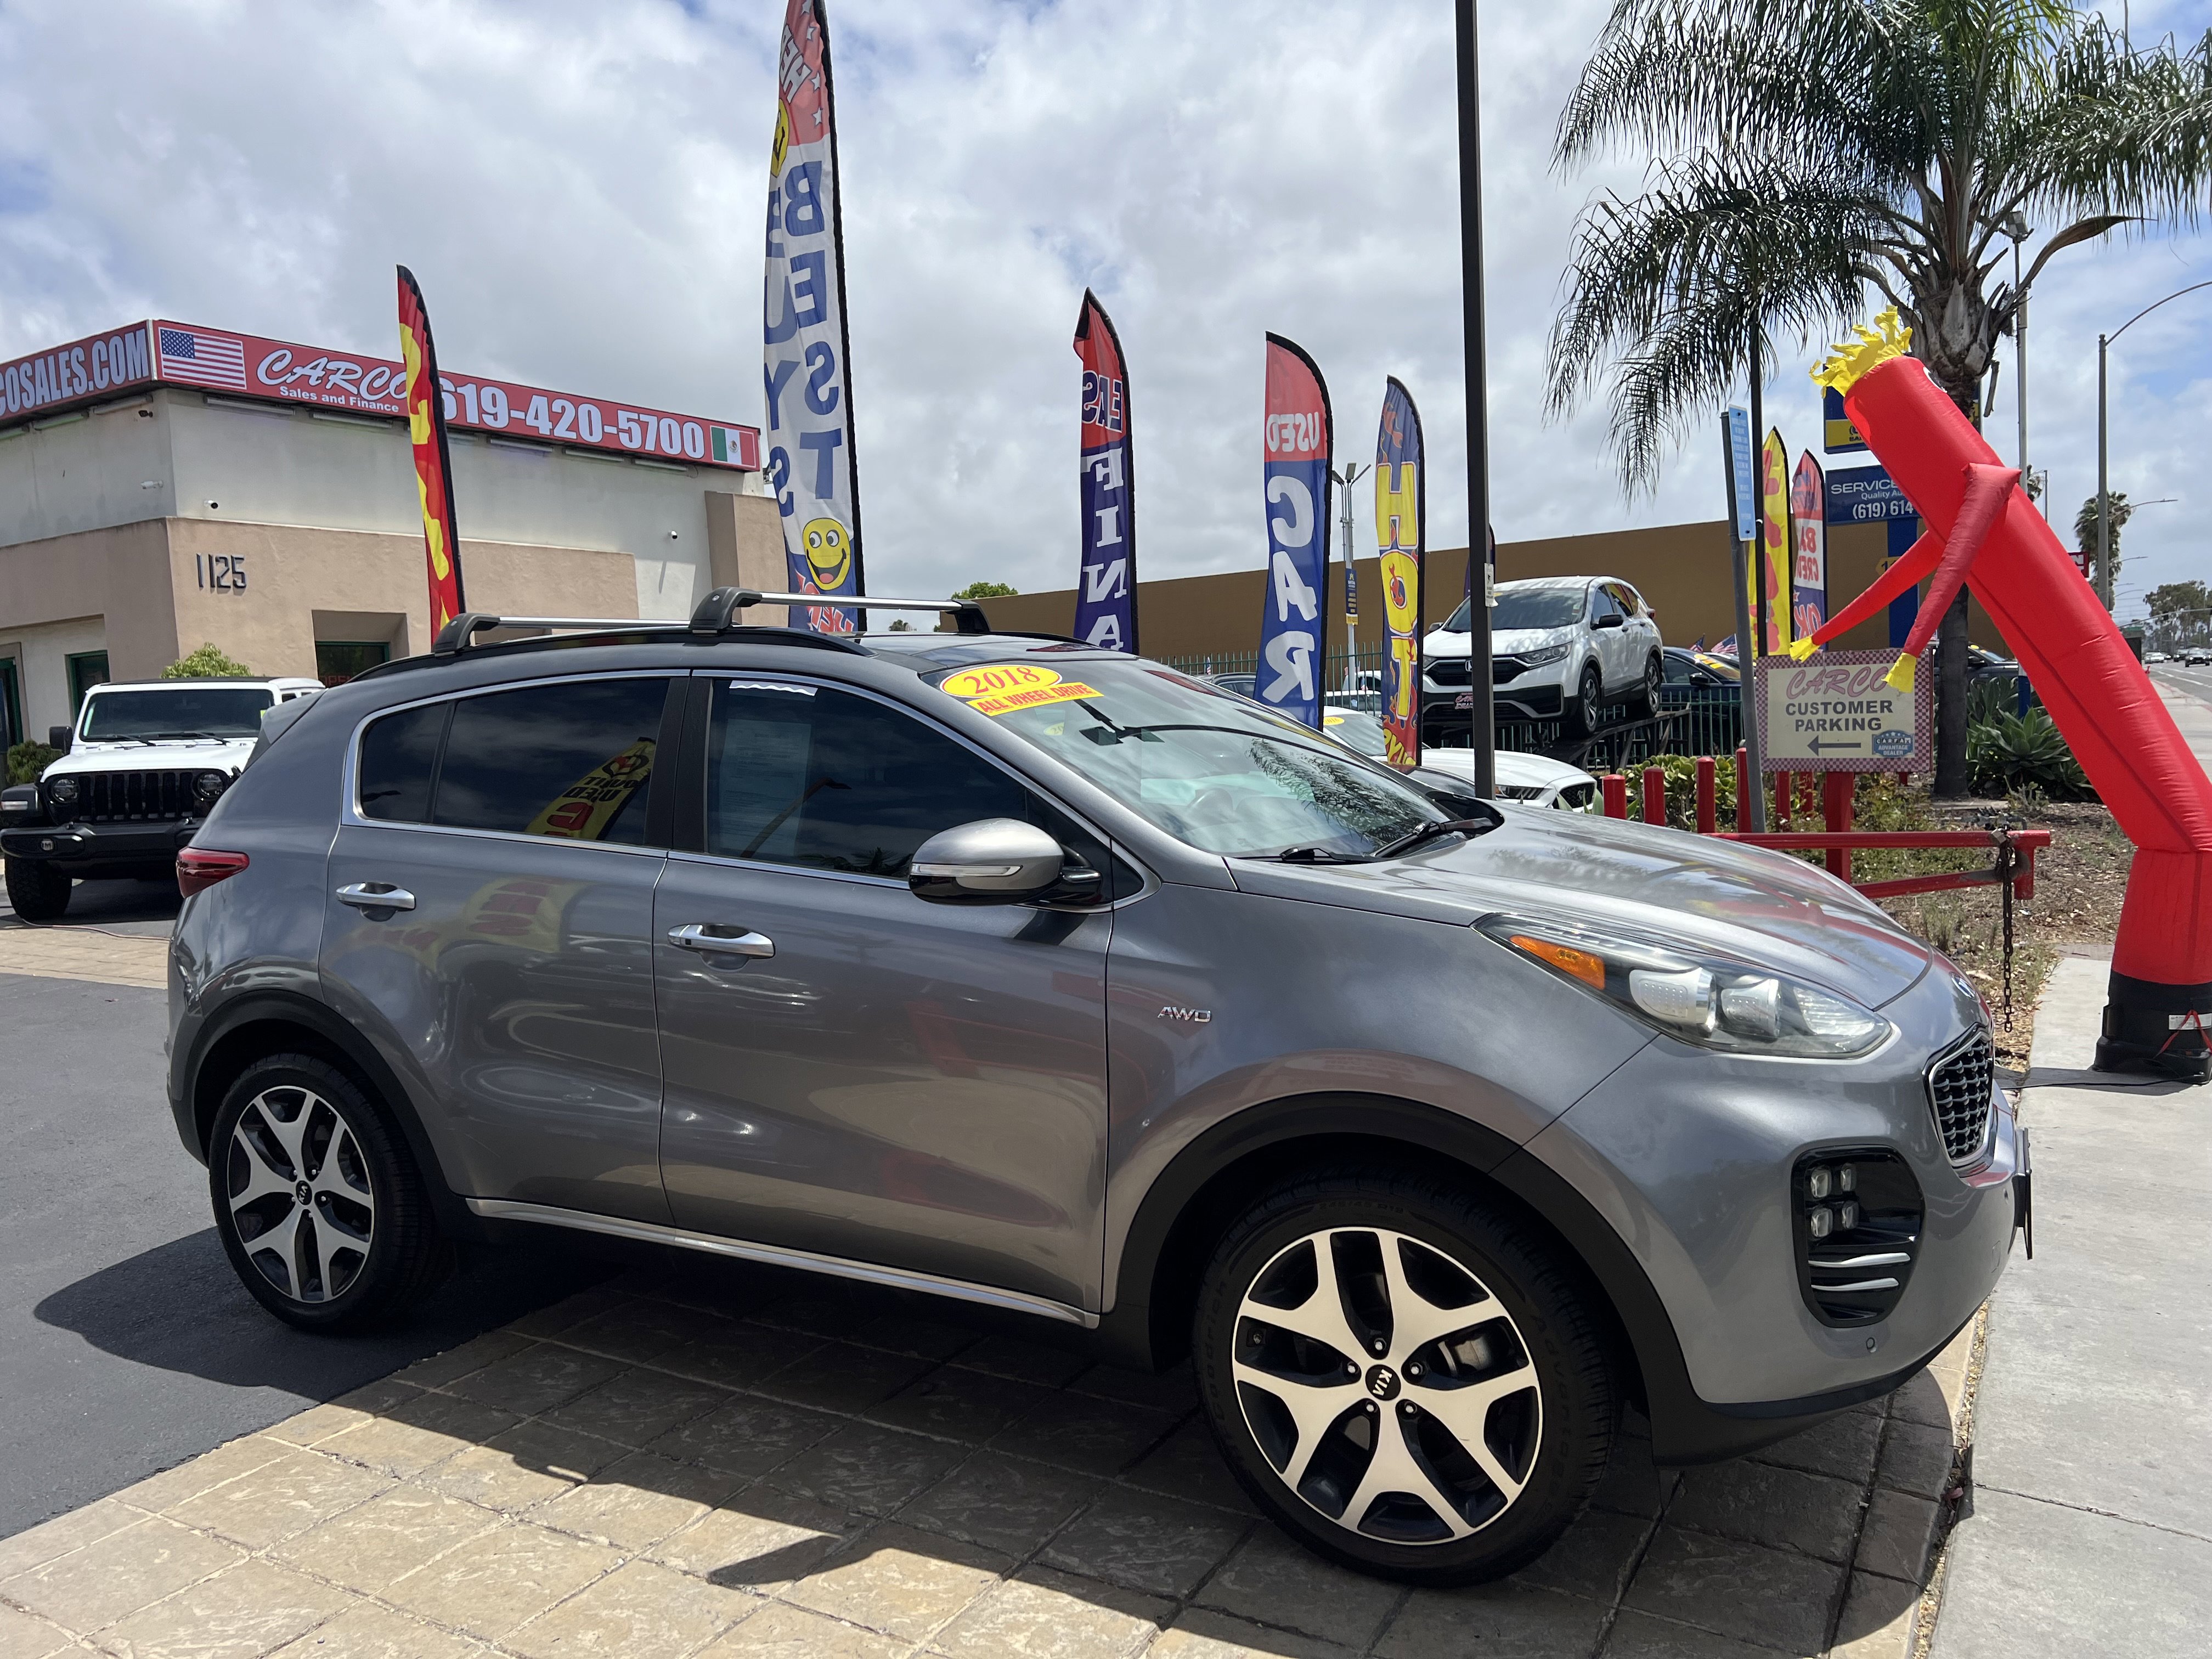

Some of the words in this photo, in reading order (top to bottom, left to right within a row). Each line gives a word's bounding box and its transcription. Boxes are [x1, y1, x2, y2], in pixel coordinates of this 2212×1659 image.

[256, 348, 407, 401] CARCO
[280, 385, 318, 401] Sales
[321, 392, 346, 405] and
[349, 396, 399, 413] Finance
[439, 376, 706, 460] 619-420-5700
[1861, 490, 1890, 500] Quality
[1852, 501, 1886, 520] (619)
[196, 552, 248, 590] 1125
[963, 667, 1041, 695] 2018
[1786, 666, 1889, 699] CARCO
[977, 699, 1010, 713] ALL
[1003, 690, 1054, 706] WHEEL
[1050, 685, 1093, 698] DRIVE
[1785, 700, 1893, 716] CUSTOMER
[1795, 717, 1882, 732] PARKING
[1156, 1006, 1211, 1023] AWD
[1372, 1369, 1393, 1396] KIA
